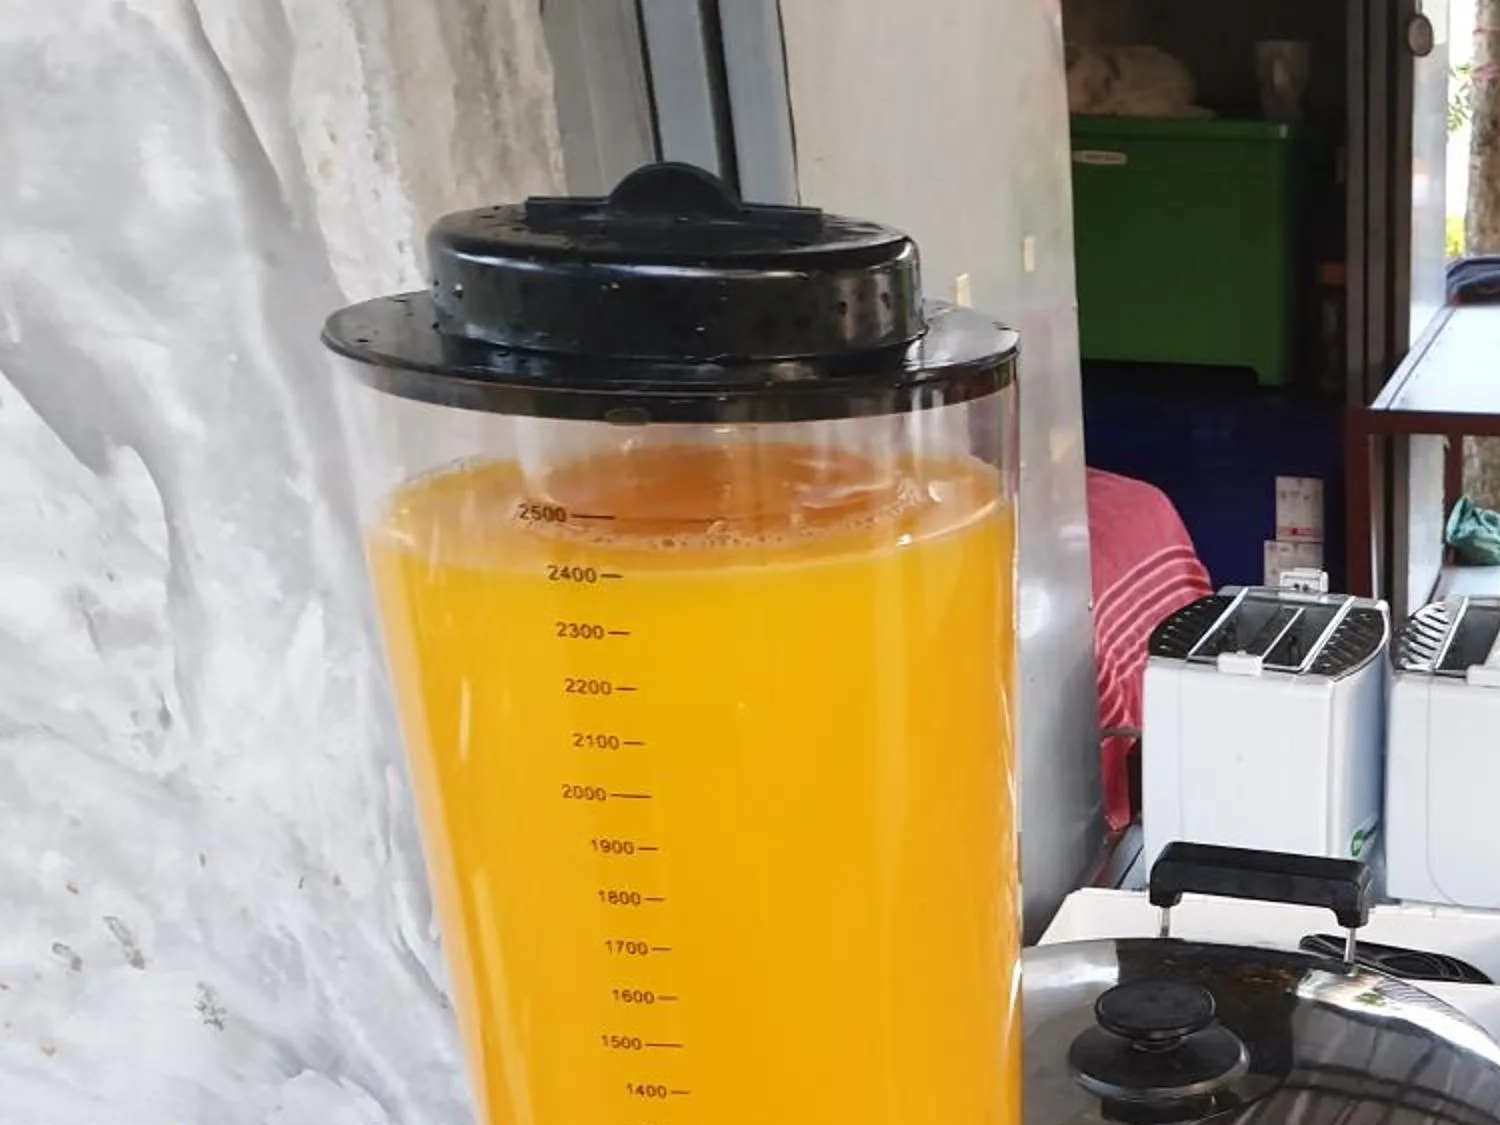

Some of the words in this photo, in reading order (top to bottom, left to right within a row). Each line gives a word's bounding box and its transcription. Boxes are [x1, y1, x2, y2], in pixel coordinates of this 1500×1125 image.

[518, 503, 567, 522] 2500
[547, 564, 597, 583] 2400
[555, 622, 604, 640] 2300
[564, 678, 612, 695] 2200
[572, 733, 620, 750] 2100
[561, 783, 607, 801] 2000
[591, 839, 635, 855] 1900
[598, 889, 641, 906] 1800
[605, 939, 649, 956] 1700
[612, 989, 655, 1004] 1600
[601, 1034, 642, 1051] 1500
[626, 1083, 667, 1099] 1400
